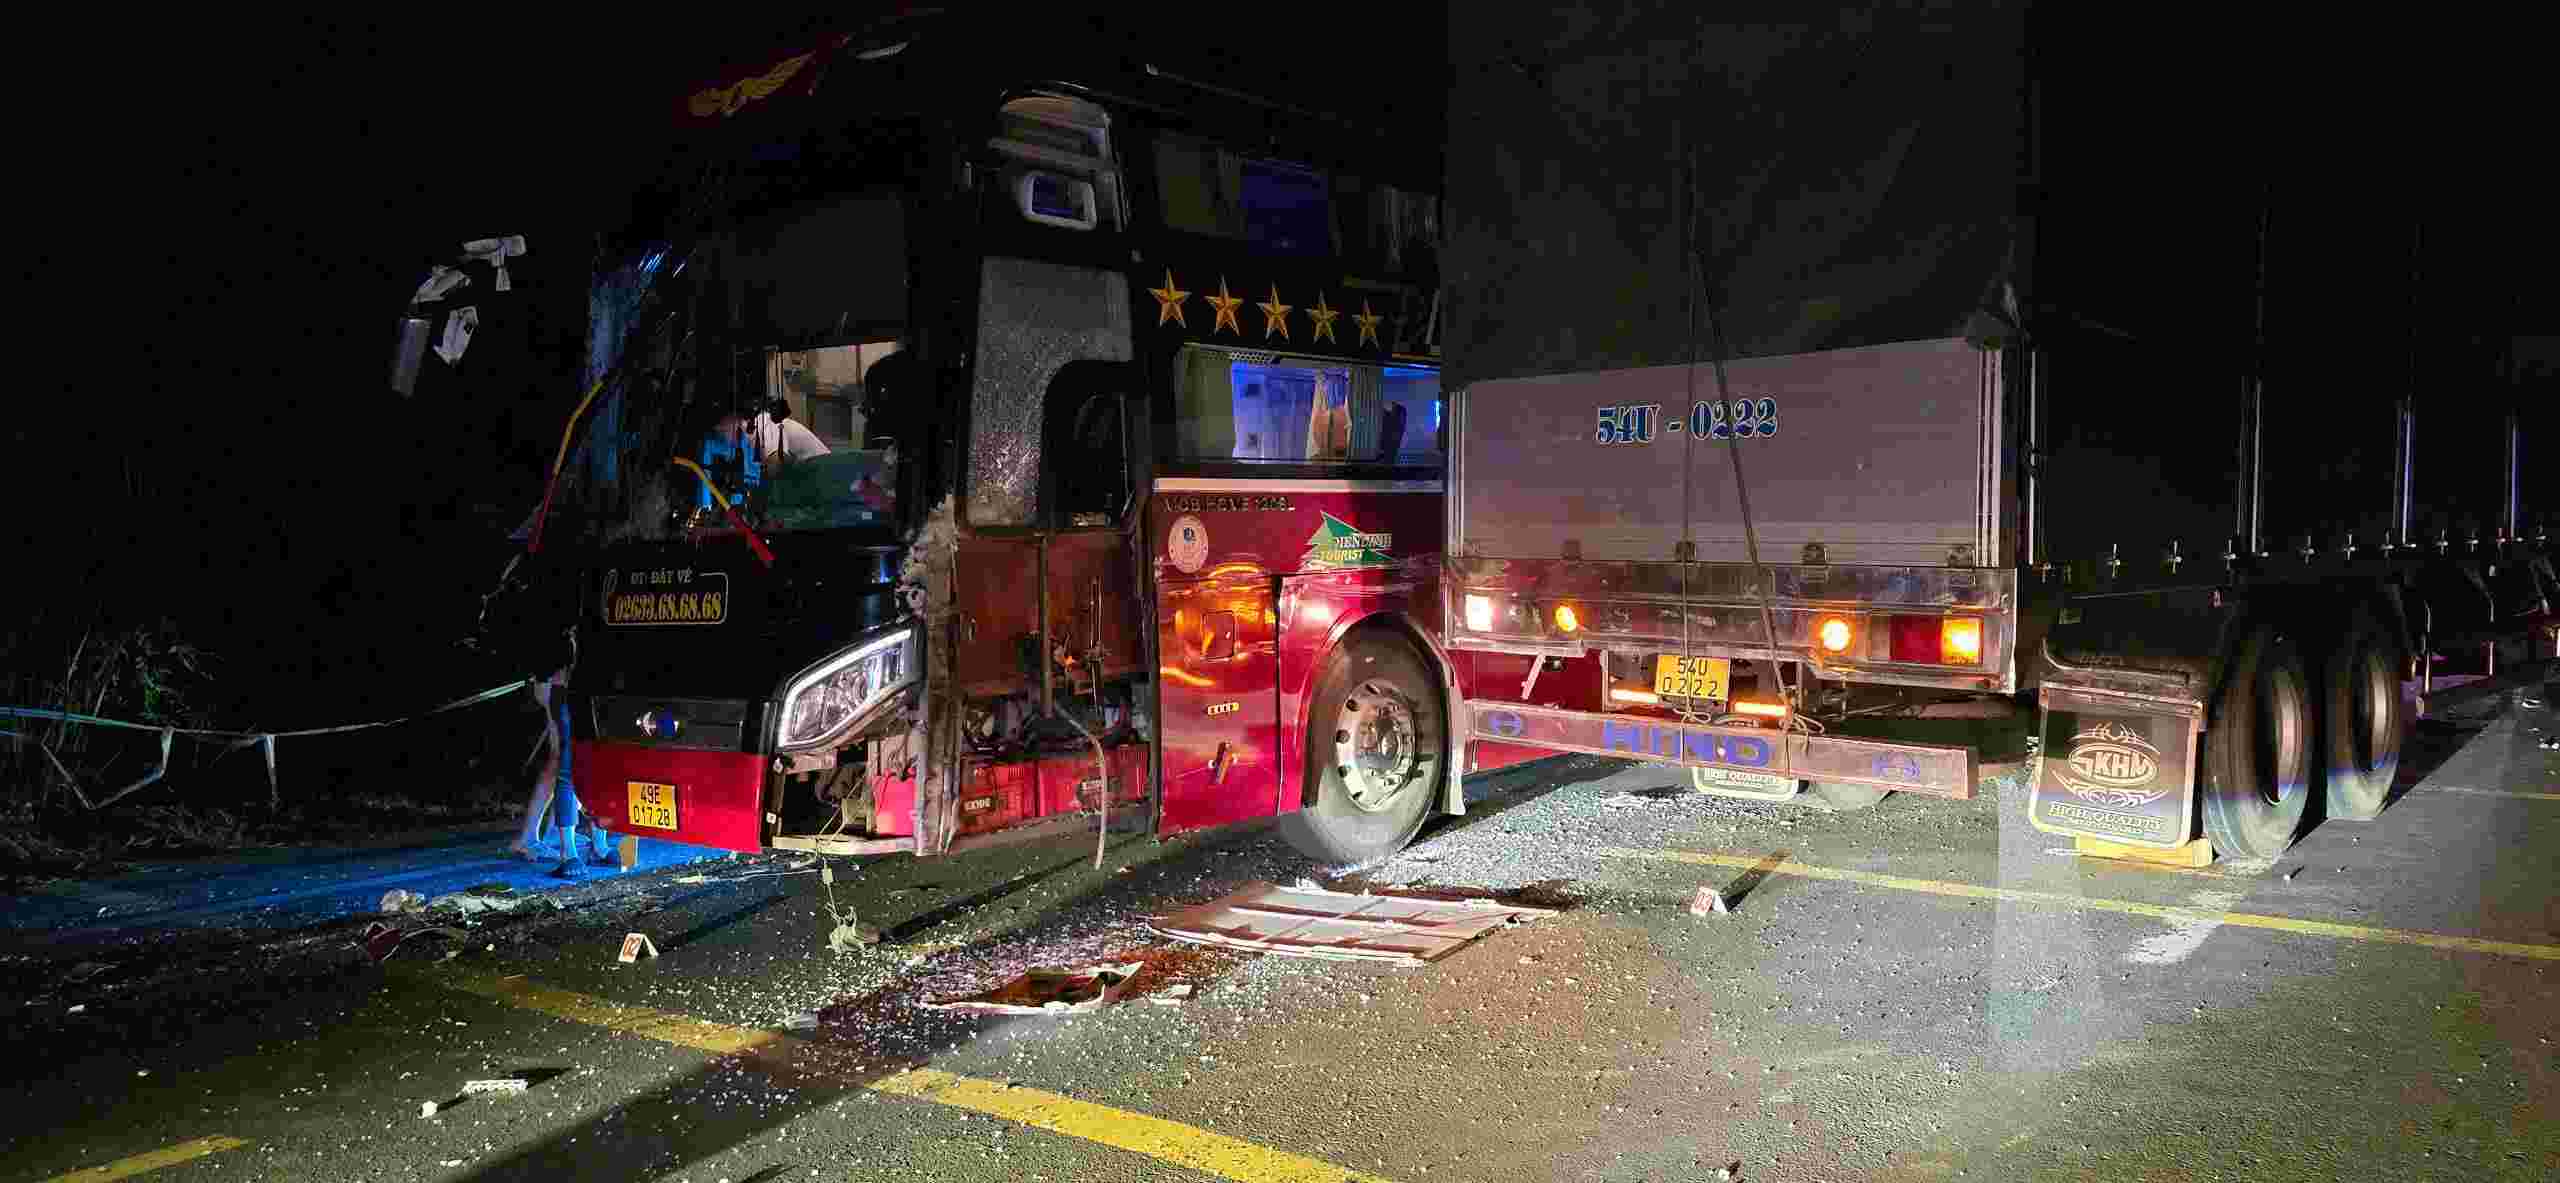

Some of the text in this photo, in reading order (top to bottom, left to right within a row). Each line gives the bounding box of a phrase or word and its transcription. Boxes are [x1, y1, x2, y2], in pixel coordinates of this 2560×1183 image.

[1596, 404, 1662, 445] 54U
[1690, 397, 1777, 440] 0222
[1320, 549, 1363, 561] TOURIST
[1676, 657, 1708, 676] 54U
[1663, 676, 1718, 697] 0222
[1603, 719, 1770, 768] HINO
[640, 784, 662, 805] 49E
[2048, 802, 2092, 820] HIGH
